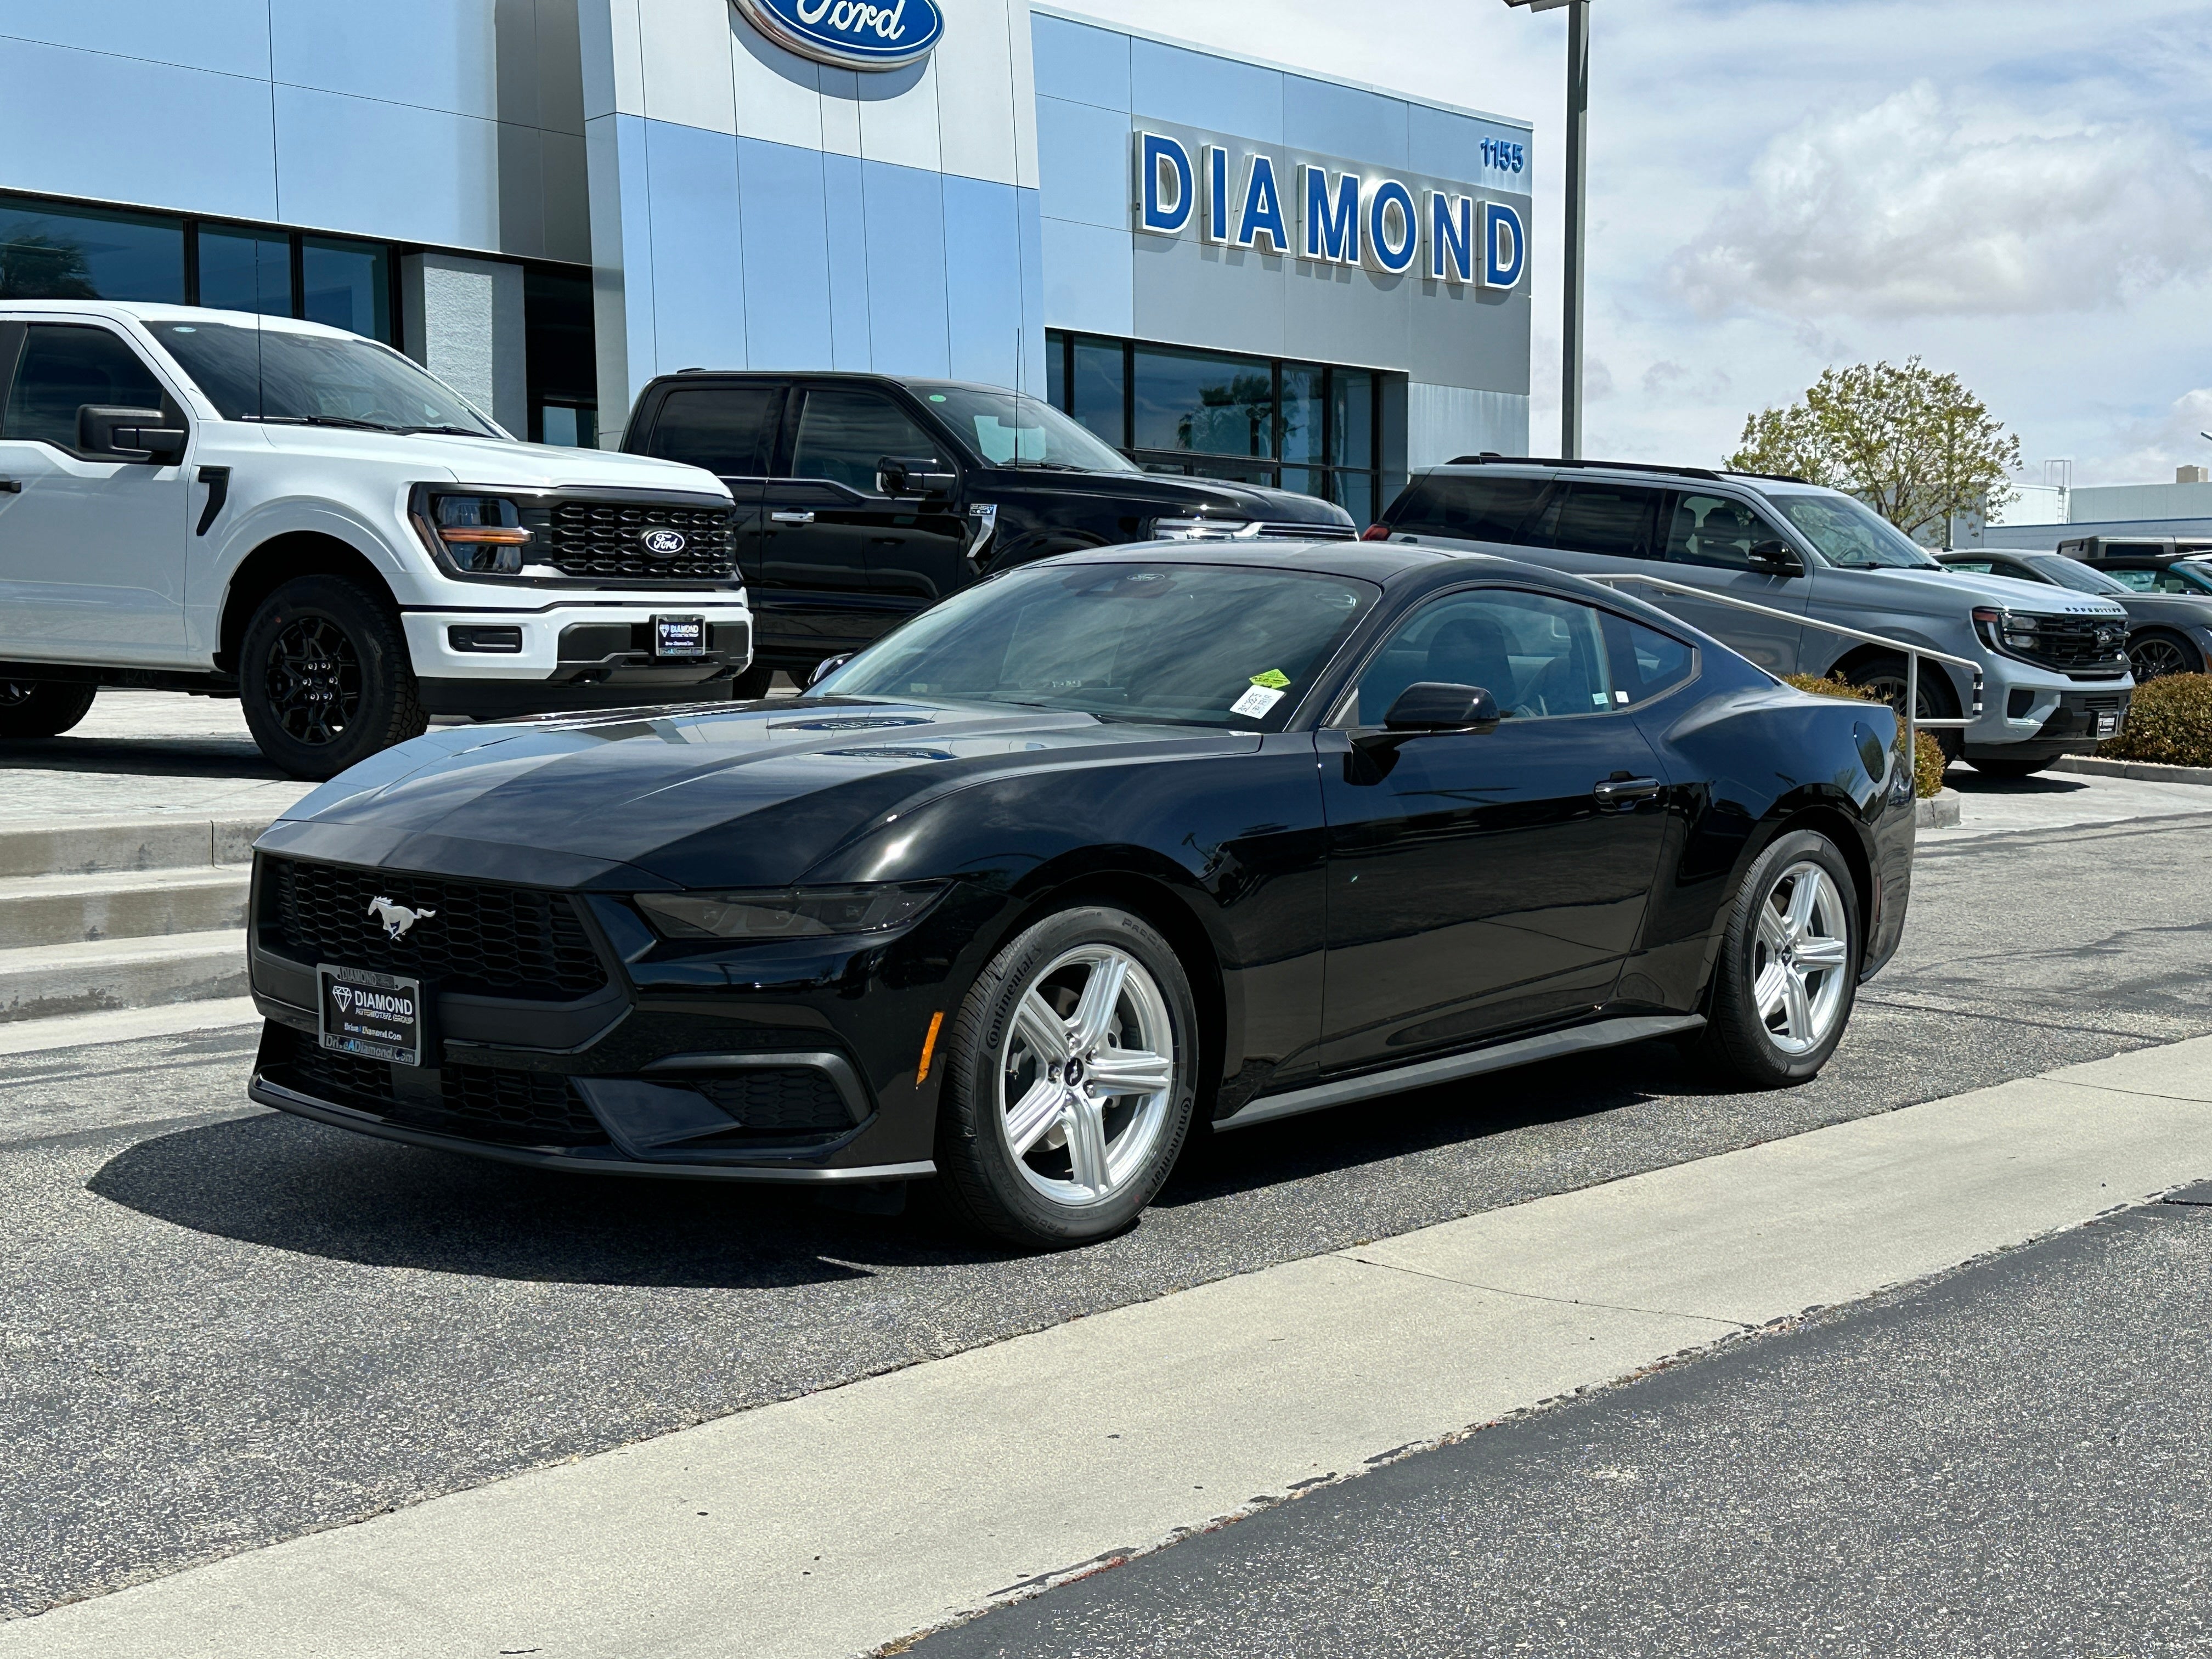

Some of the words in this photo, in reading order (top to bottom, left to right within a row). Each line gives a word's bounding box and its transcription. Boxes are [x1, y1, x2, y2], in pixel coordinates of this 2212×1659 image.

[1480, 137, 1523, 173] 1155
[1140, 130, 1526, 289] DIAMOND
[653, 533, 677, 549] Ford
[354, 990, 413, 1015] DIAMOND
[986, 952, 1034, 1049] Continental
